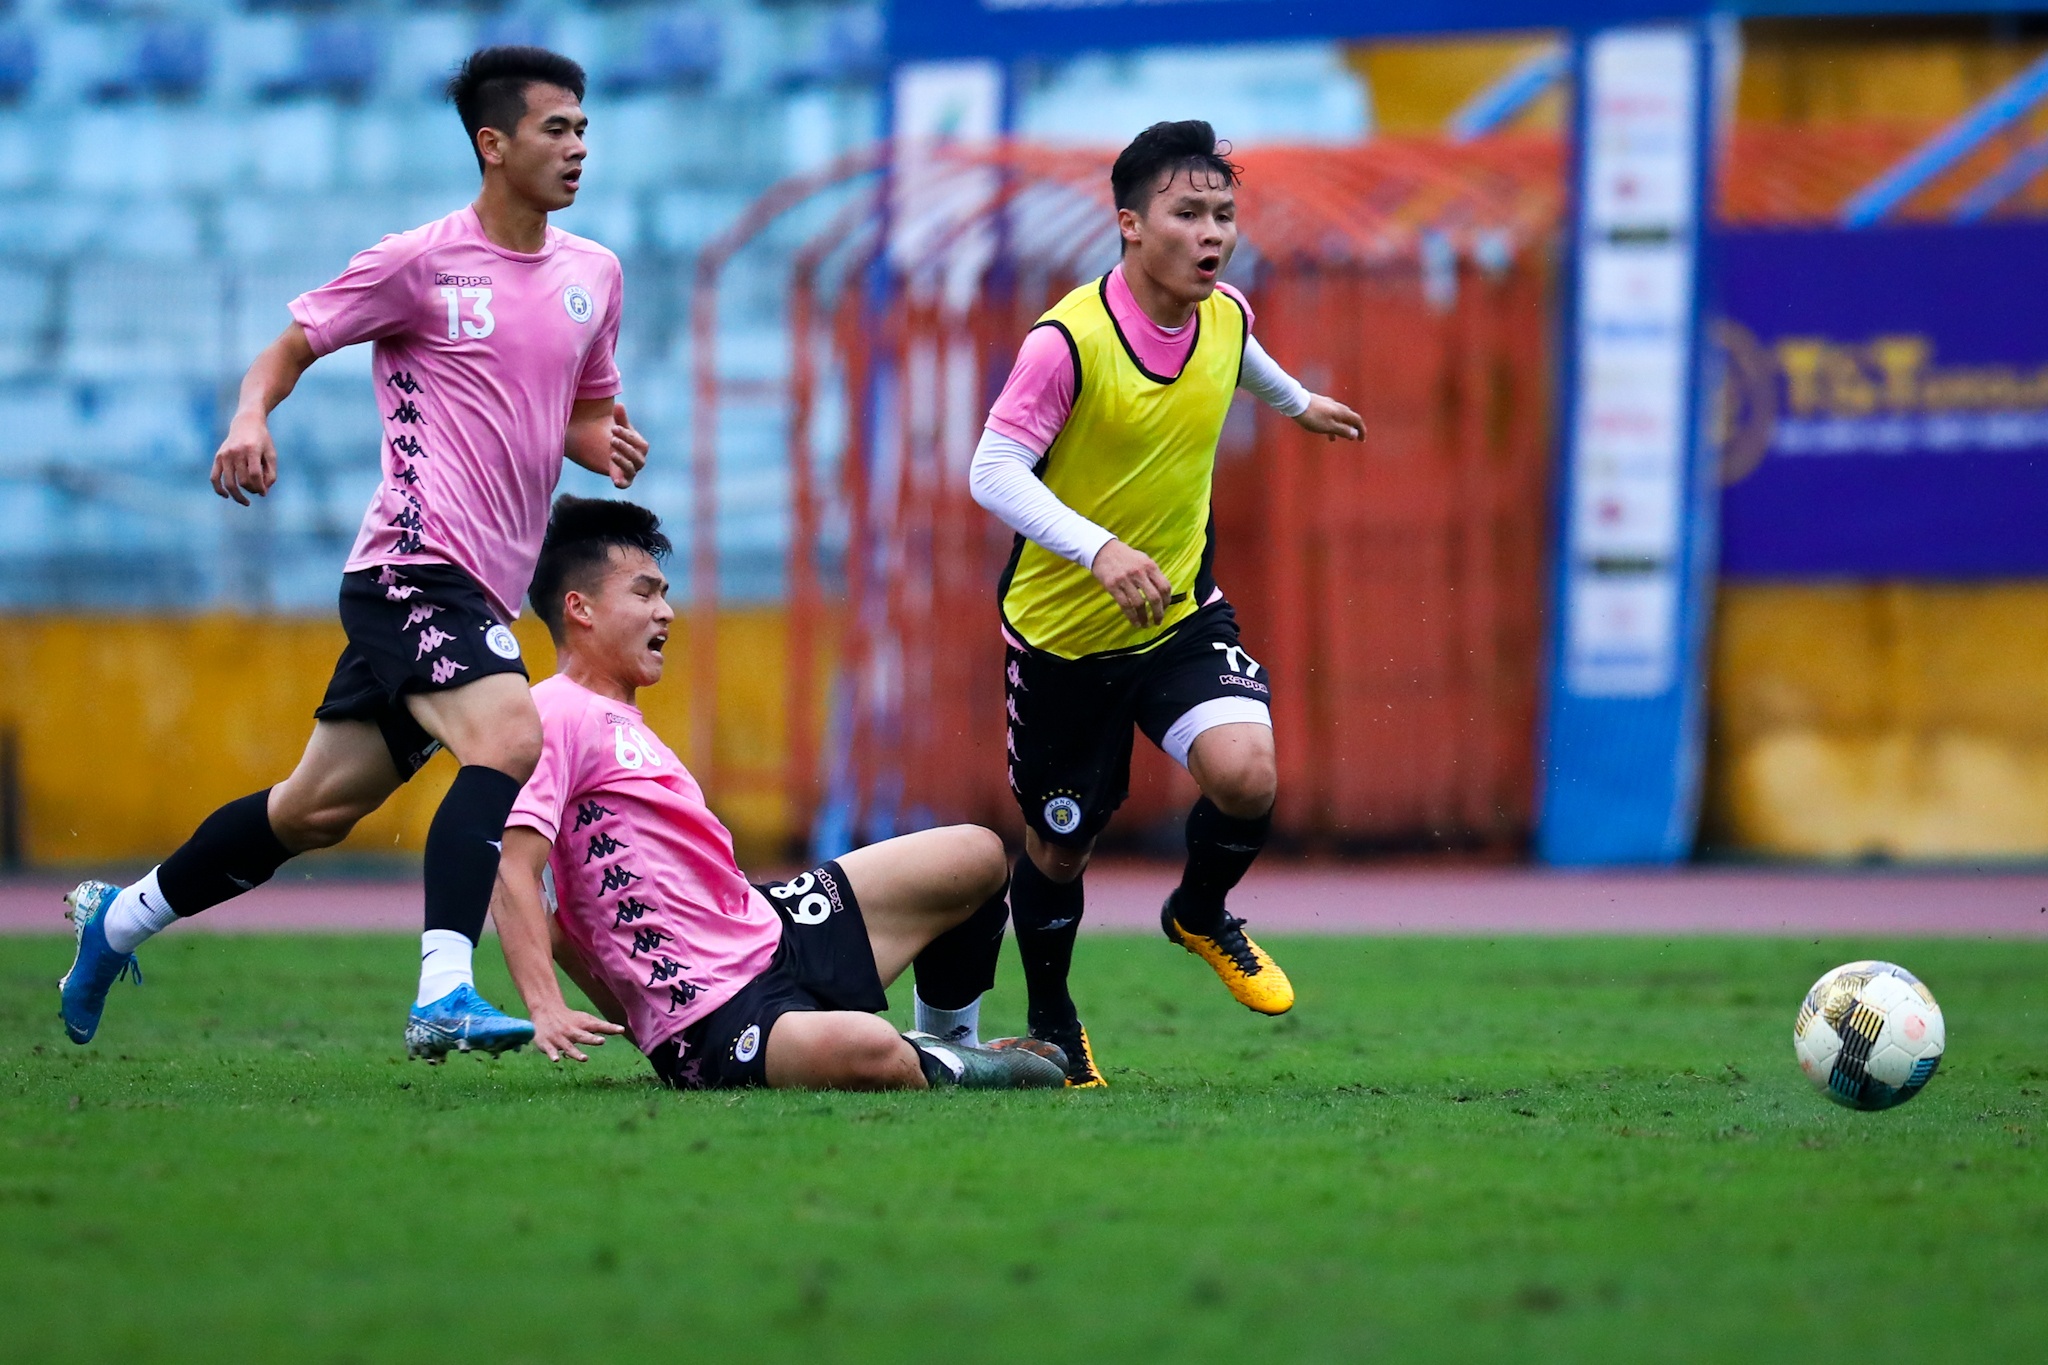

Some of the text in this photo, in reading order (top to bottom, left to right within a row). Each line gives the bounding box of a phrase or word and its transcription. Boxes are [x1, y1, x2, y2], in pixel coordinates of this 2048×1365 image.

[434, 273, 493, 287] Kappa
[440, 287, 496, 340] 13
[1211, 642, 1261, 679] 77
[1219, 674, 1269, 694] Kappa
[614, 725, 663, 770] 68
[1049, 799, 1074, 809] HANOI
[769, 871, 832, 925] 68
[813, 867, 844, 913] Kappa
